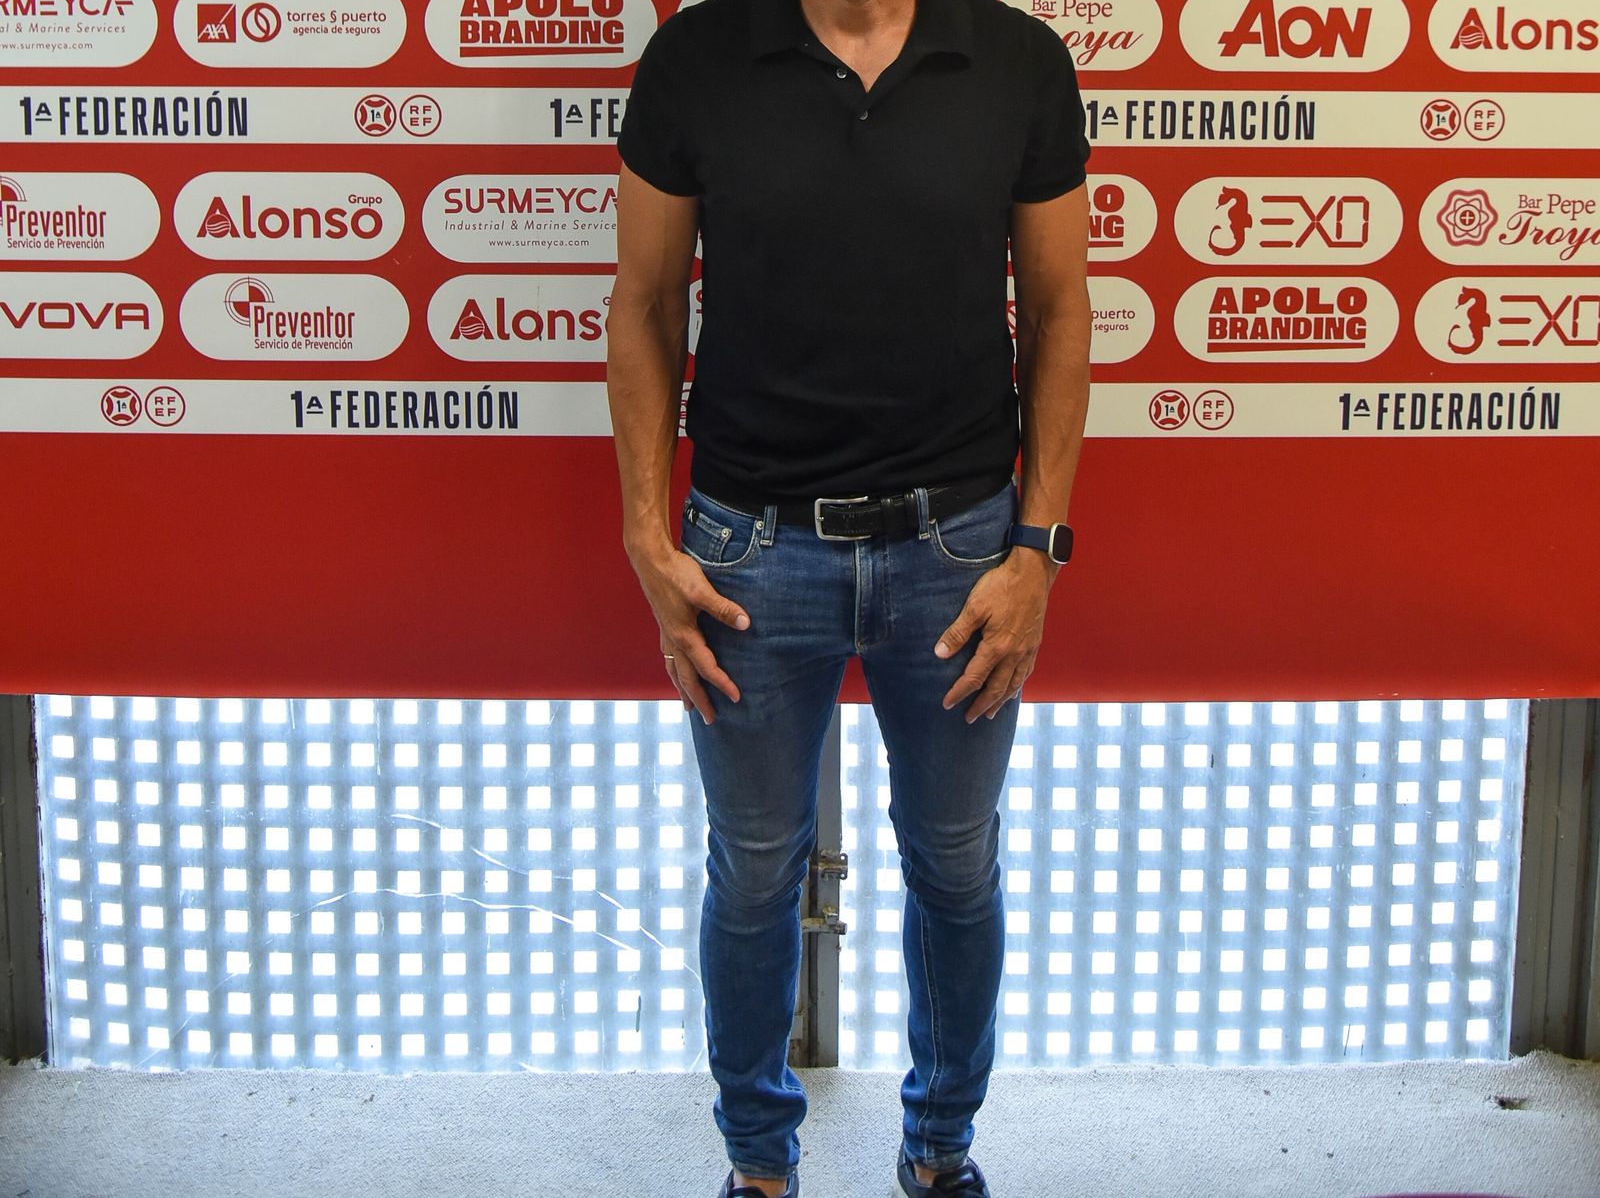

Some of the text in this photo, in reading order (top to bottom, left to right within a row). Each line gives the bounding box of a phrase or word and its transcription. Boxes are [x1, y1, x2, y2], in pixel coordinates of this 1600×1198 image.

[29, 22, 70, 33] Marine
[77, 22, 126, 33] Services
[287, 11, 325, 22] torres
[342, 11, 386, 25] puerto
[293, 25, 380, 36] agencia de seguros
[1450, 6, 1600, 51] Alons
[460, 20, 624, 44] BRANDING
[1061, 30, 1144, 66] oya
[59, 91, 247, 136] FEDERACIÓN
[1126, 95, 1315, 140] FEDERACIÓN
[348, 195, 382, 206] Grupo
[1518, 194, 1595, 221] Bar Pepe
[6, 204, 106, 237] Preventor
[197, 195, 383, 240] Alonso
[445, 220, 616, 230] Industrial & Marine Service
[8, 238, 104, 248] Servicio de Prevención
[489, 240, 589, 249] www.surmeyca.com
[1209, 287, 1367, 314] APOLO
[254, 306, 355, 338] Preventor
[450, 298, 607, 340] Alons
[1095, 324, 1128, 332] seguros
[1208, 317, 1366, 340] BRANDING
[255, 339, 352, 349] Servicio de Prevención
[331, 385, 518, 429] FEDERACIÓN
[1377, 386, 1560, 430] FEDERACIÓN
